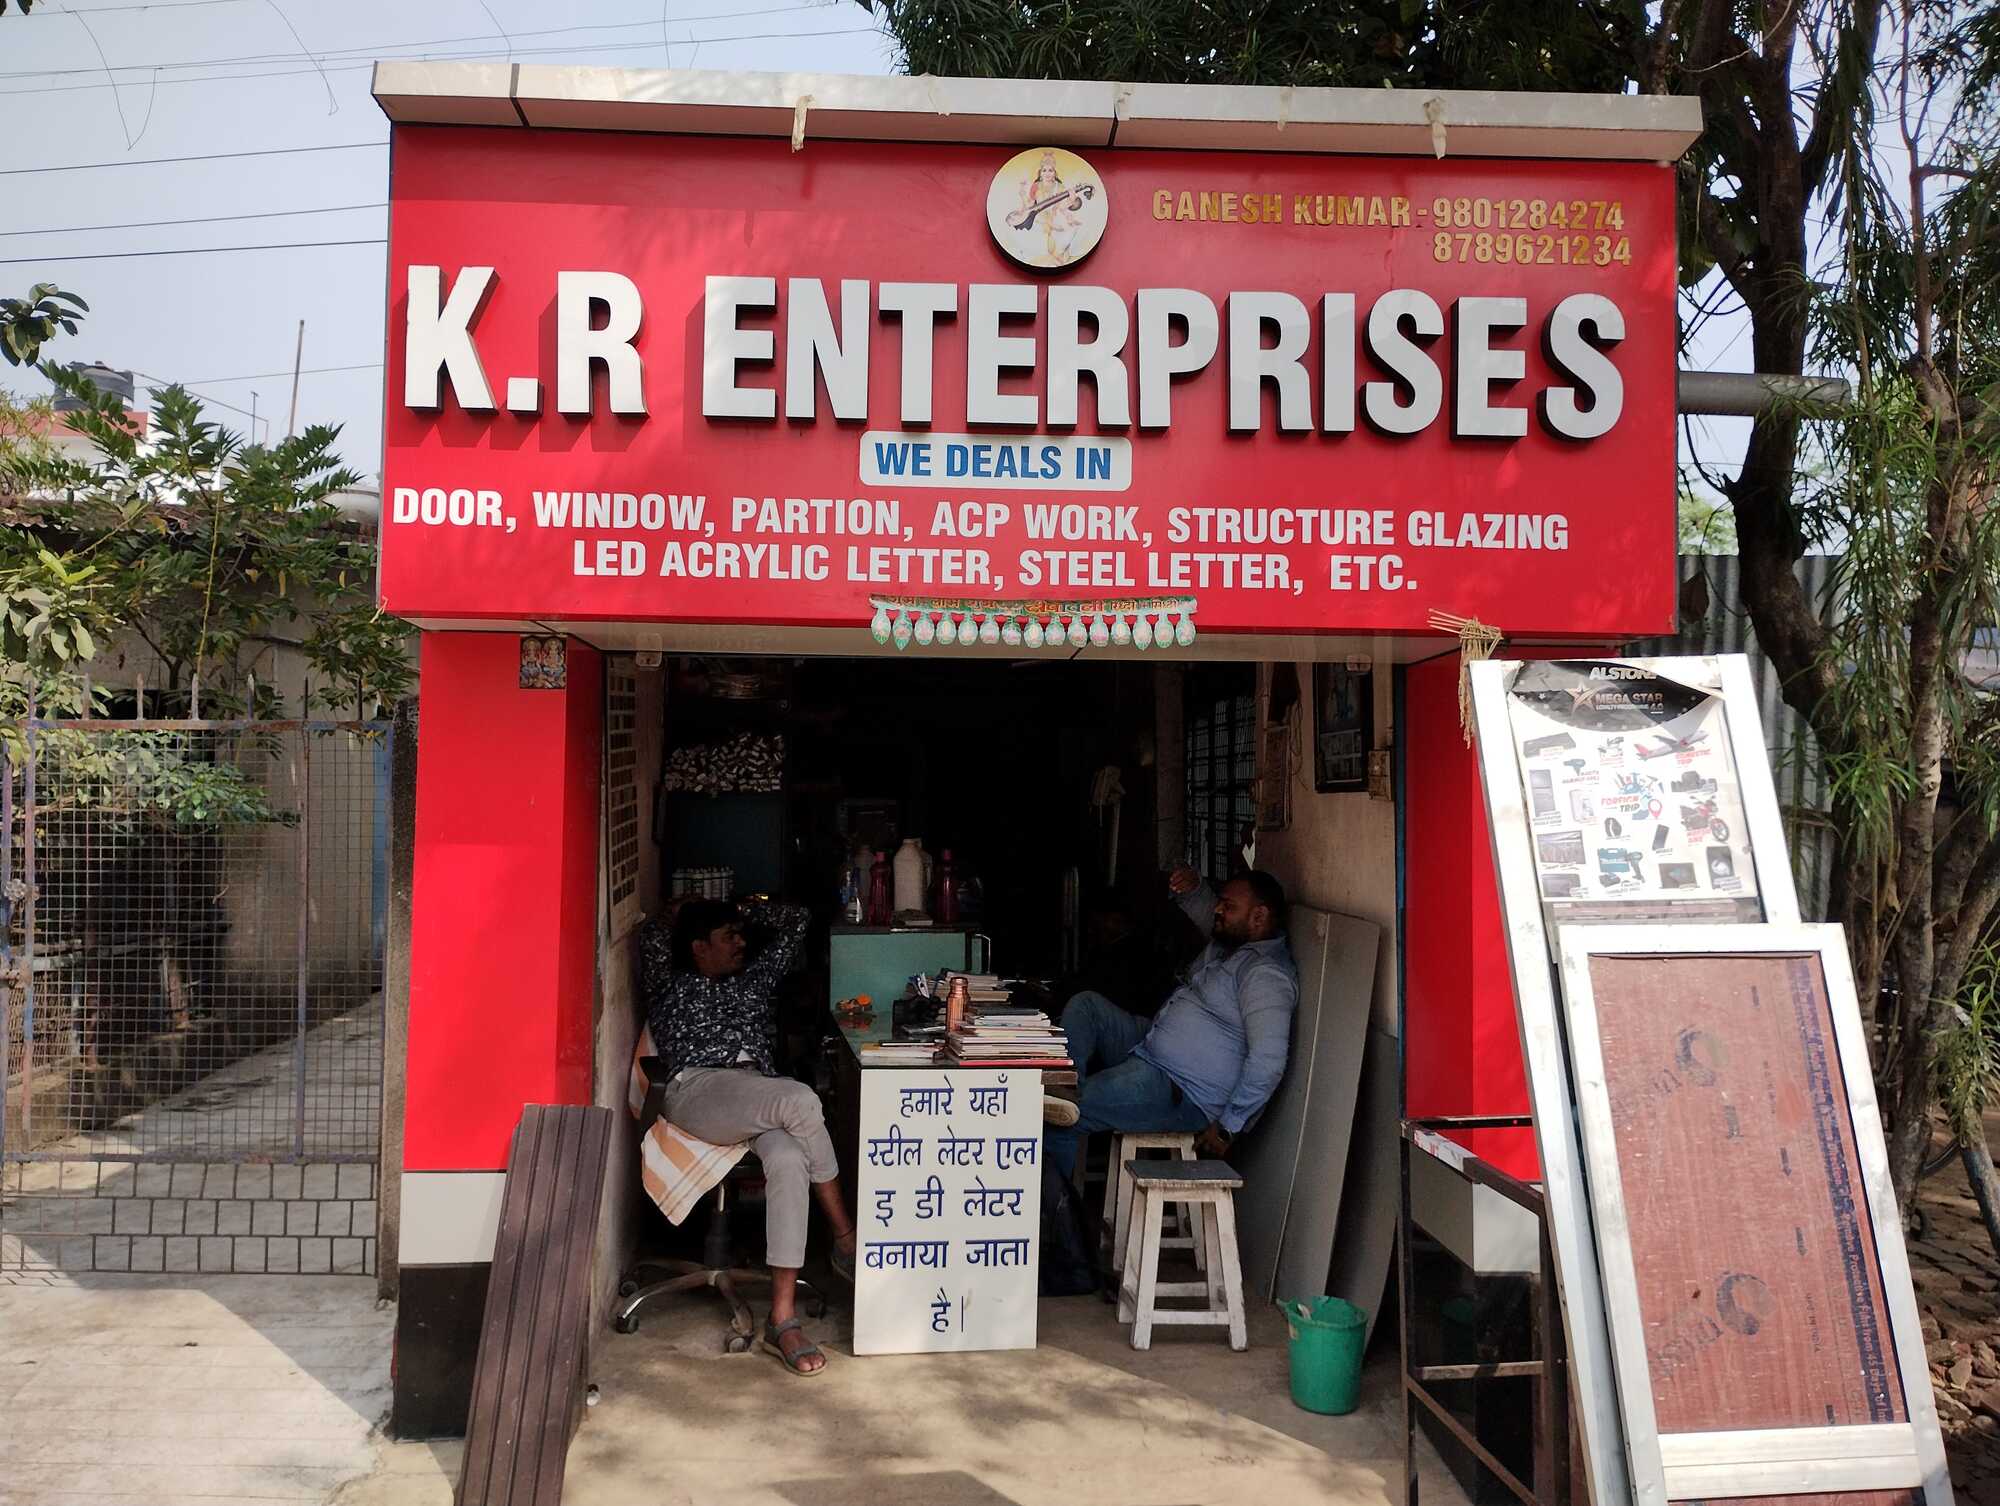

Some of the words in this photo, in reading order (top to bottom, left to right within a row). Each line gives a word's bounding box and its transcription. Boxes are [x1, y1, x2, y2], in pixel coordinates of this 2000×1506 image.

[1152, 190, 1283, 223] GANESH
[1433, 233, 1633, 267] 8789621234
[404, 264, 648, 415] K.R
[702, 276, 1626, 440] ENTERPRISES
[874, 442, 932, 477] WE
[945, 444, 1062, 479] DEALS
[1075, 447, 1112, 479] IN
[392, 488, 518, 533] DOOR,
[532, 491, 715, 538] WINDOW,
[731, 497, 914, 543] PARTION,
[929, 501, 1011, 538] ACP
[1023, 503, 1152, 548] WORK,
[1167, 507, 1395, 545] STRUCTURE
[1406, 510, 1569, 550] GLAZING
[573, 540, 646, 577] LED
[659, 541, 830, 581] ACRYLIC
[846, 545, 1004, 592] LETTER,
[1018, 550, 1136, 587] STEEL
[1147, 552, 1304, 596] LETTER,
[1329, 555, 1418, 591] ETC.
[1595, 692, 1630, 704] MEGA
[1632, 692, 1664, 704] STAR
[900, 1074, 954, 1118] हमारे
[969, 1073, 1008, 1117] यहाँ
[868, 1124, 923, 1166] स्टील
[938, 1125, 985, 1166] लेटर
[995, 1138, 1038, 1170] एल
[875, 1190, 896, 1227] इ
[915, 1175, 945, 1219] डी
[963, 1175, 1024, 1217] लेटर
[865, 1241, 949, 1269] बनाया
[965, 1238, 1030, 1266] जाता
